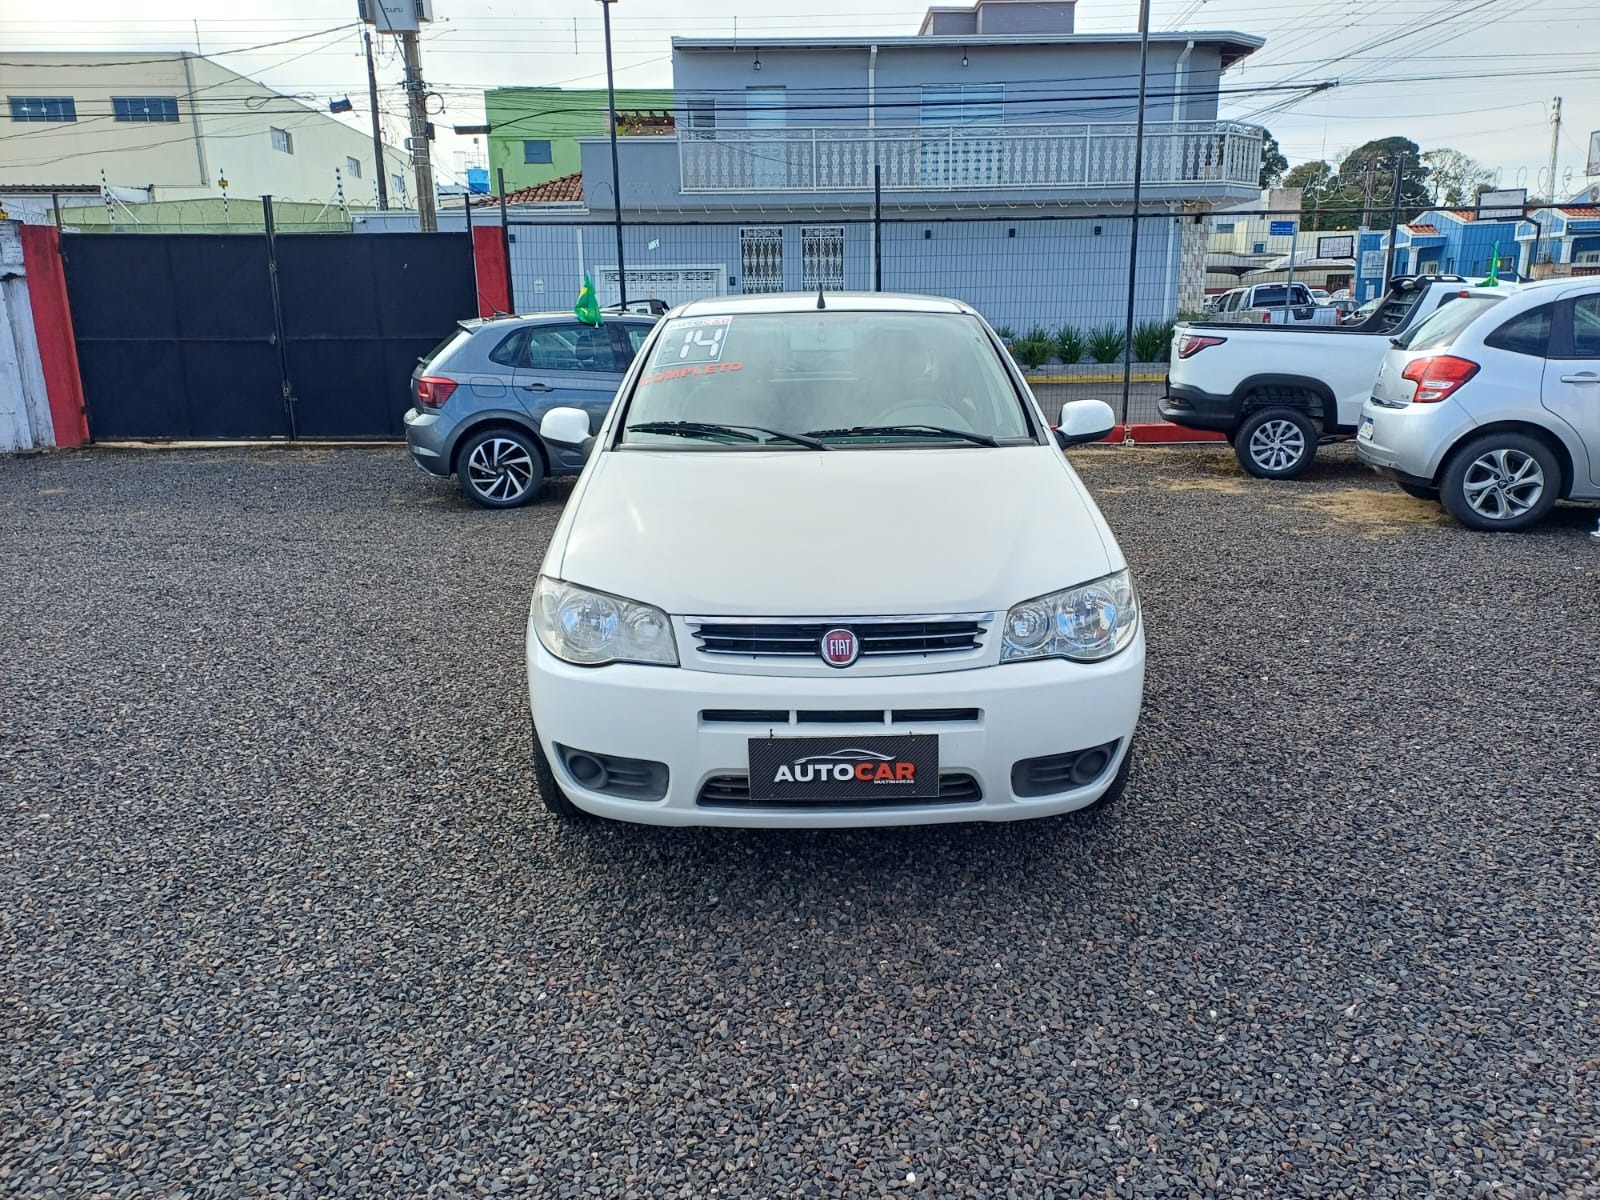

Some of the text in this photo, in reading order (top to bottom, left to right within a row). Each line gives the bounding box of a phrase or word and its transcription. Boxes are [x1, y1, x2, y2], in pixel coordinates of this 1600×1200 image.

[679, 328, 723, 359] 14
[640, 361, 743, 386] COMPLETO
[830, 639, 851, 656] FIAT
[774, 762, 915, 782] AUTOCAR
